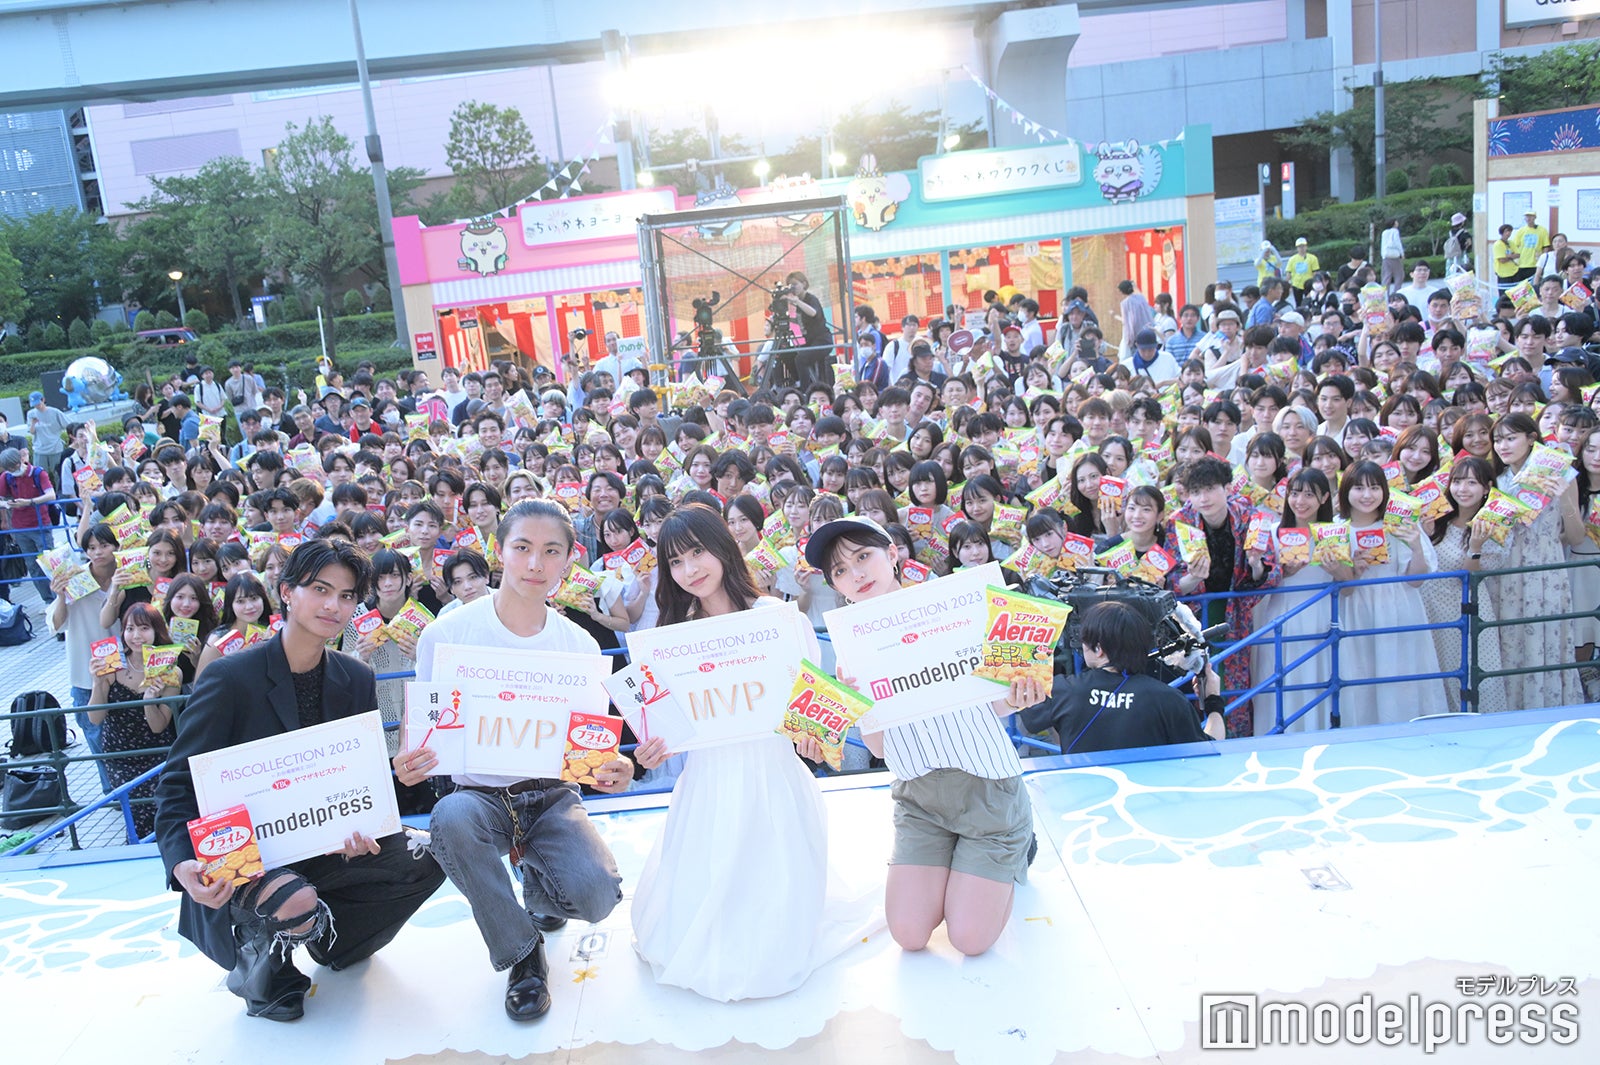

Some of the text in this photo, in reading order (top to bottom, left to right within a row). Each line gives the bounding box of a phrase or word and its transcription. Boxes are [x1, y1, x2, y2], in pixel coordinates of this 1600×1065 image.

[1386, 500, 1413, 516] Aerial
[1318, 527, 1347, 540] Aerial
[572, 572, 599, 588] Aerial
[852, 602, 949, 638] MISCOLLECTION
[952, 590, 984, 610] 2023
[1014, 613, 1049, 624] エアリアル
[921, 618, 972, 638] ヤマザキビスケット
[988, 613, 1055, 643] Aerial
[653, 634, 746, 661] MISCOLLECTION
[750, 628, 780, 643] 2023
[991, 645, 1021, 657] コーン
[718, 654, 767, 668] ヤマザキビスケット
[456, 665, 588, 687] MISCOLLECTION 2023
[500, 692, 514, 701] YBC
[519, 693, 569, 704] ヤマザキビスケット
[688, 680, 764, 721] MVP
[818, 694, 848, 714] エアリアル
[1088, 688, 1135, 709] STAFF
[427, 692, 441, 723] 目録
[789, 689, 849, 733] Aerial
[477, 715, 557, 749] MVP
[578, 729, 611, 744] プライム
[220, 748, 325, 784] MISCOLLECTION
[329, 738, 361, 758] 2023
[294, 764, 347, 784] ヤマザキビスケット
[273, 780, 290, 790] YBC
[325, 785, 370, 803] モデルプレス
[255, 795, 373, 841] modelpress
[205, 831, 245, 851] プライム
